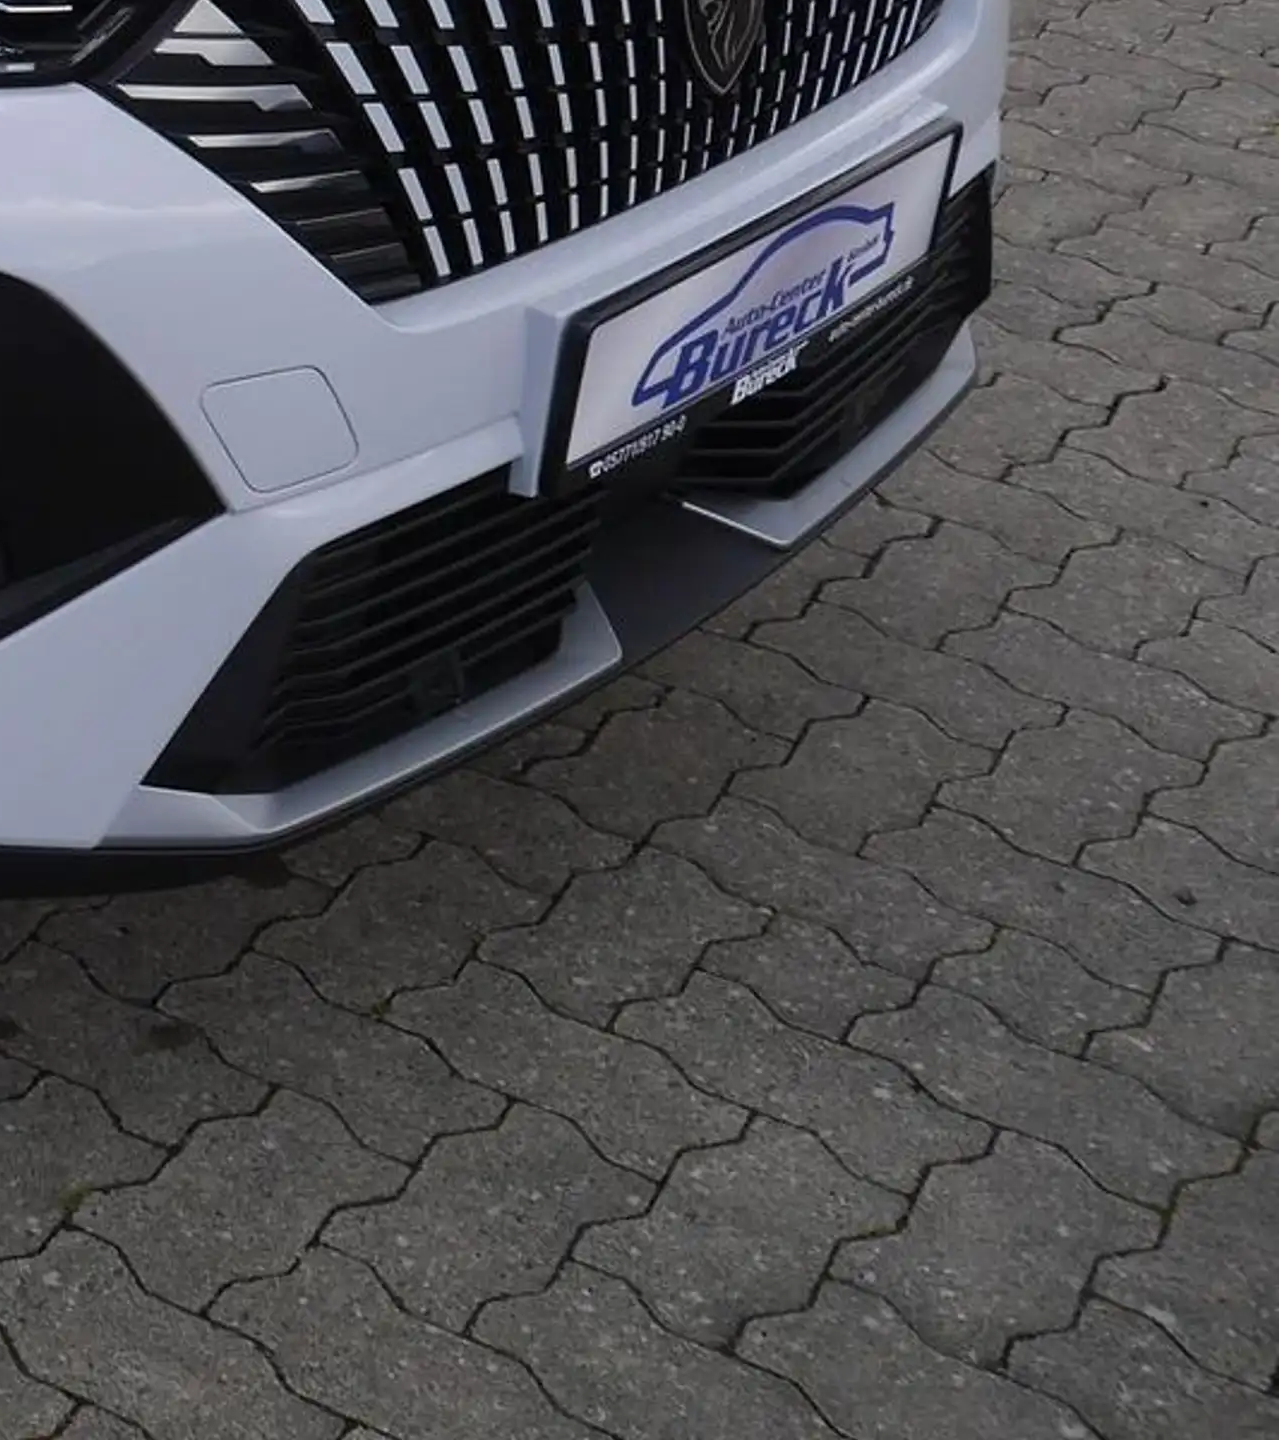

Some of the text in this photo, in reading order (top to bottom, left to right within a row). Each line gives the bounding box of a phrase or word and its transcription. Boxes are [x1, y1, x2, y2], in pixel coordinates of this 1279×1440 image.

[661, 254, 855, 409] Bureck
[722, 268, 827, 333] Auto-Center
[730, 347, 798, 406] Bureck
